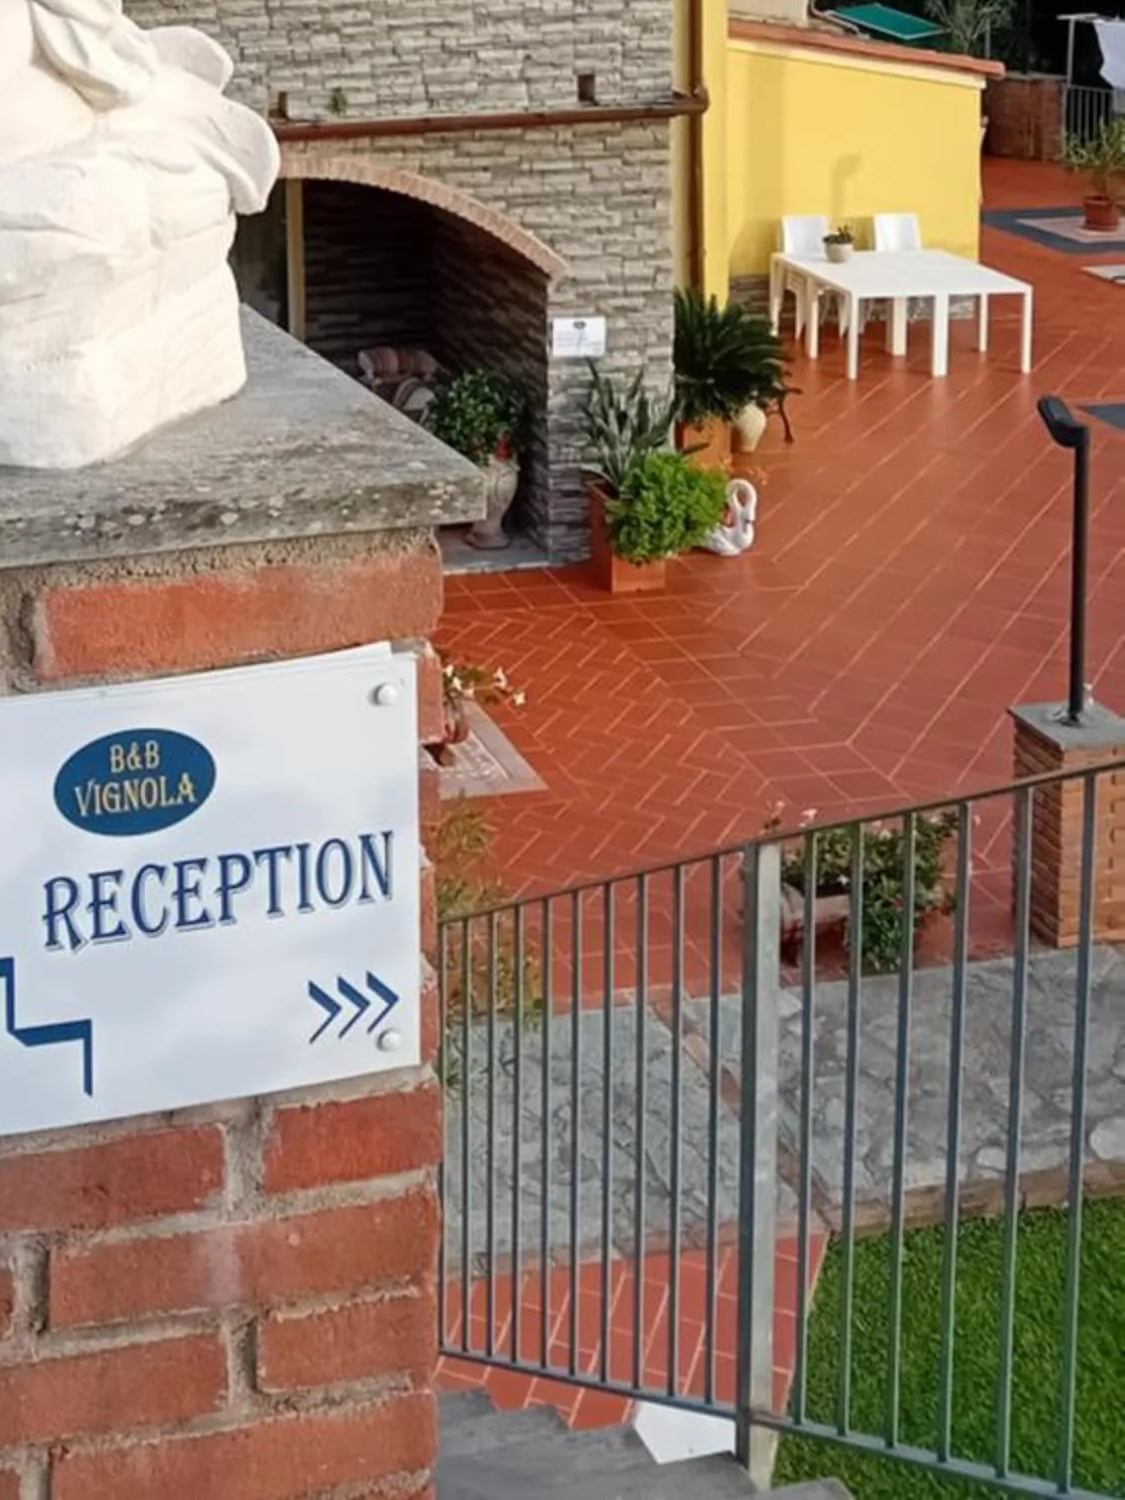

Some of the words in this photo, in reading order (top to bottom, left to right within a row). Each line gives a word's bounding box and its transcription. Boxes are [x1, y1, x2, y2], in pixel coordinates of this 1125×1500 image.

[109, 739, 161, 774] B&B
[74, 771, 197, 818] VIGNOLA
[41, 829, 394, 951] RECEPTION
